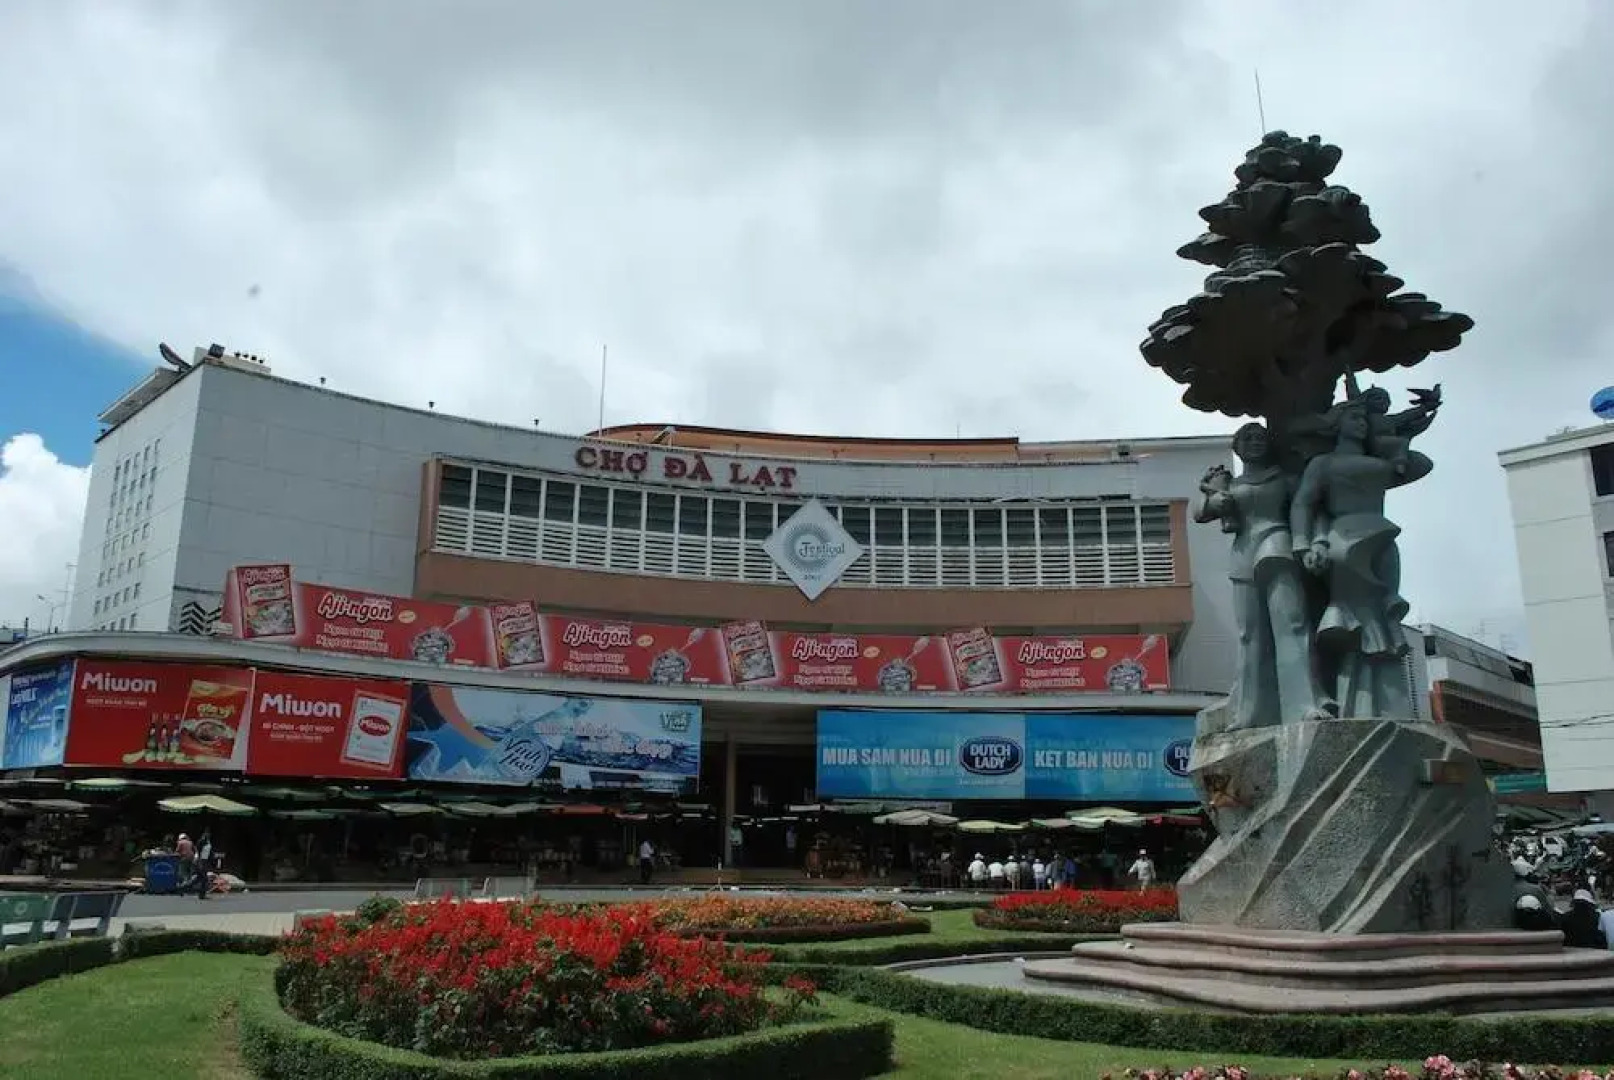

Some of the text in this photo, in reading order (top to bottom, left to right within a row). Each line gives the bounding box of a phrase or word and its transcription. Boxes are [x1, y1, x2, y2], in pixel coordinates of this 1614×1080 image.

[574, 446, 797, 491] CHỢ ĐÀ LẠT
[81, 671, 157, 693] Miwon
[259, 692, 342, 718] Miwon
[969, 743, 1012, 758] DUTCH
[974, 756, 1007, 769] LADY
